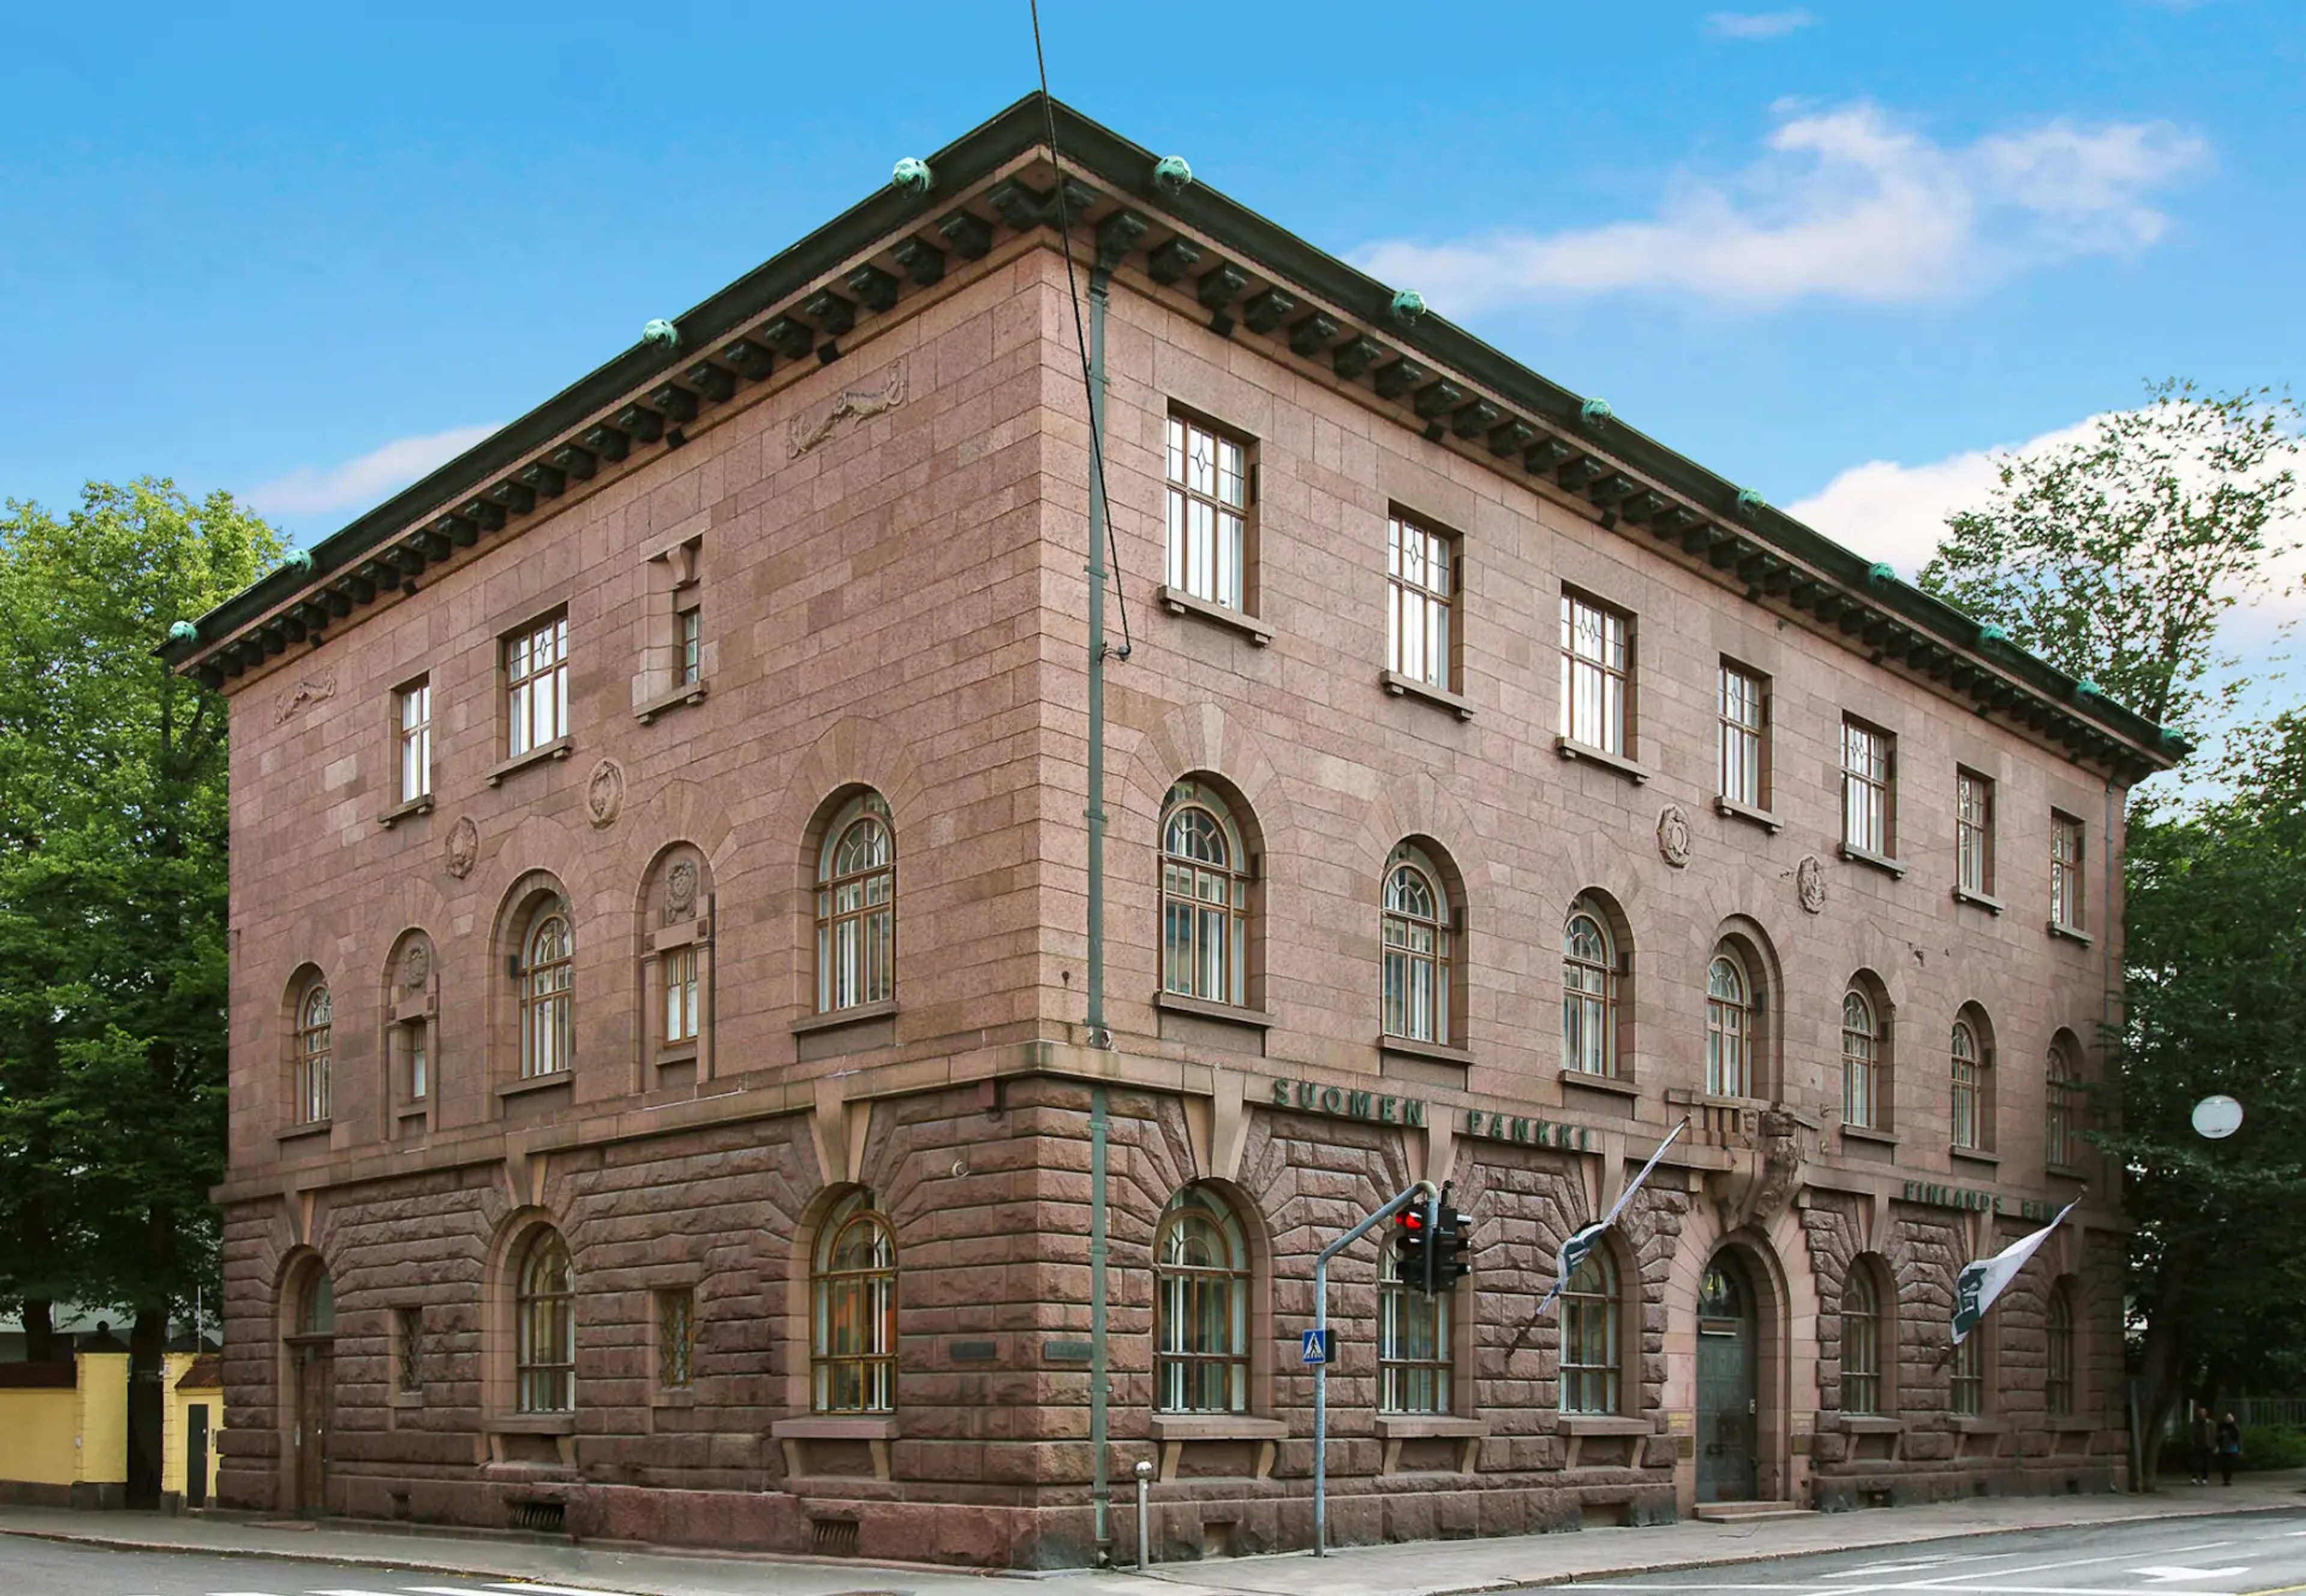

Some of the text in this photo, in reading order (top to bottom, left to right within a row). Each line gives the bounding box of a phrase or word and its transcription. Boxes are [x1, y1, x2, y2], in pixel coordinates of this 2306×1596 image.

[1274, 1078, 1588, 1151] SUOMEN PANKKI
[1905, 1179, 2002, 1213] FINLANDS
